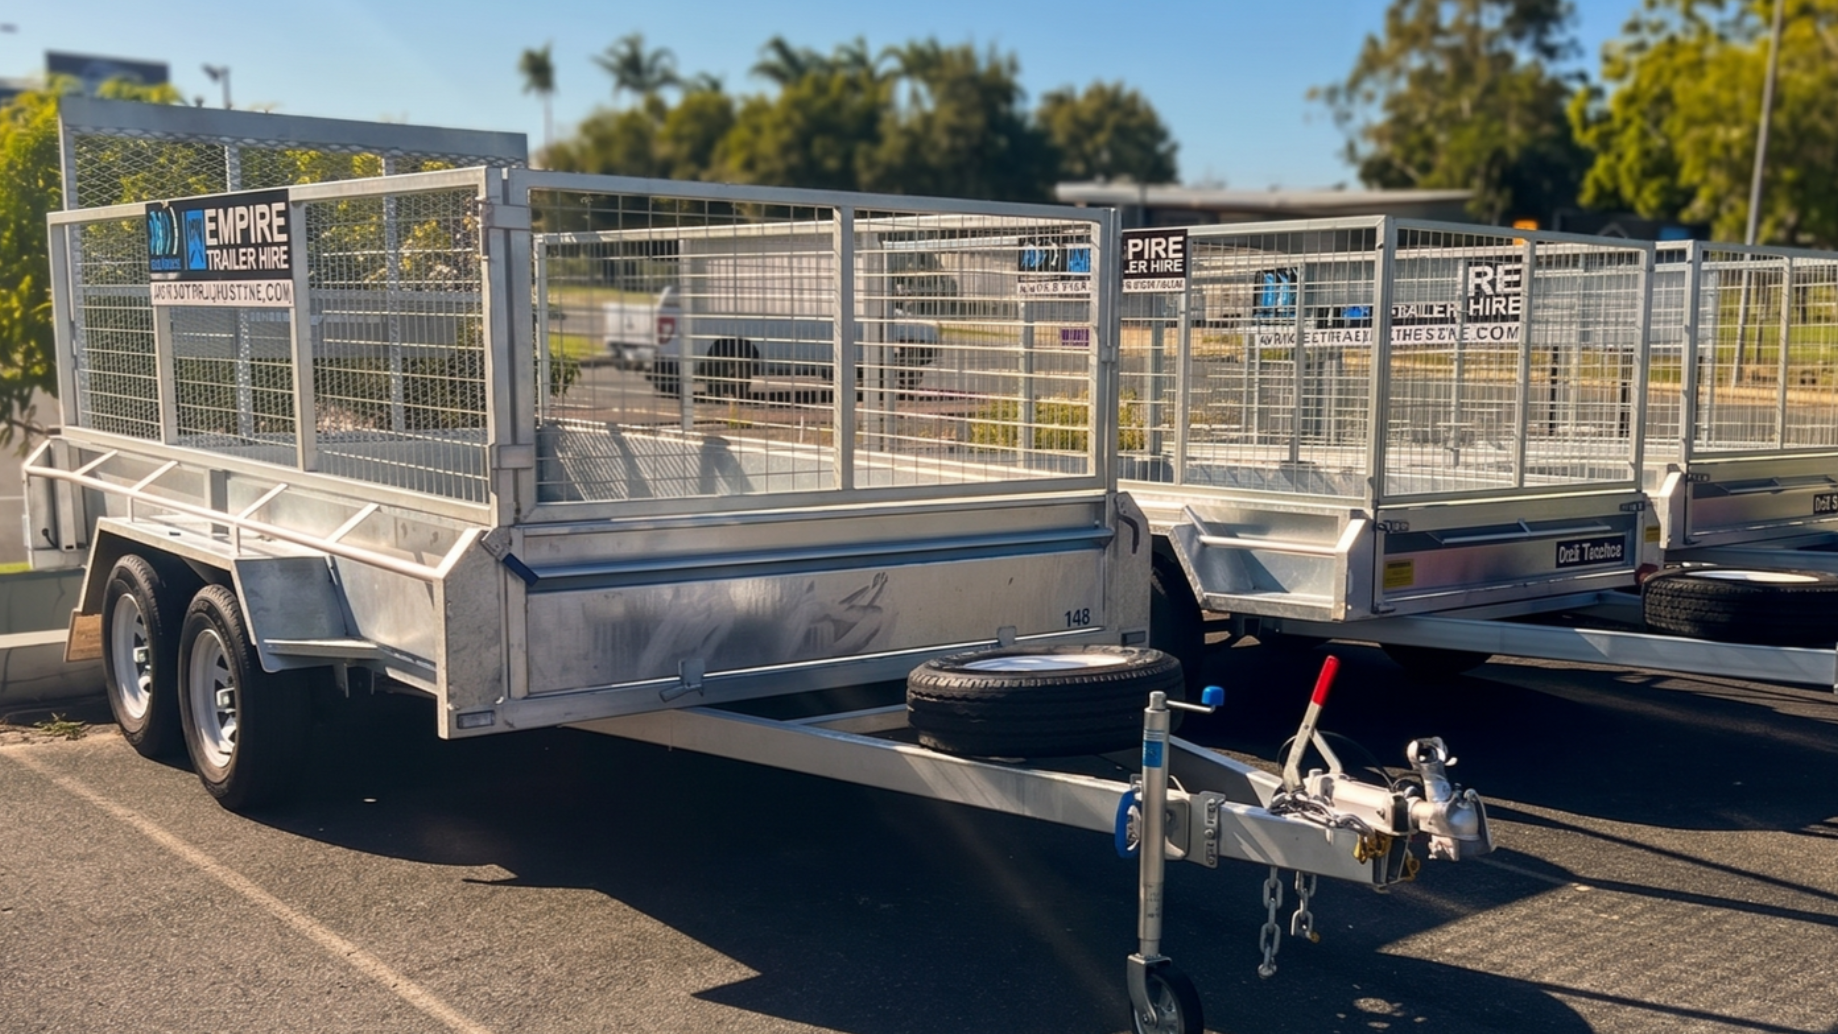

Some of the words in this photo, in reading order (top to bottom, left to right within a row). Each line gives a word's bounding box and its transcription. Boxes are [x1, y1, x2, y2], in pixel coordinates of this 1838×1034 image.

[204, 202, 288, 246] EMPIRE
[206, 247, 257, 271] TRAILER
[258, 246, 290, 269] HIRE
[1127, 236, 1184, 260] PIRE
[1150, 259, 1184, 273] HIRE
[1468, 296, 1521, 317] HIRE
[1064, 607, 1091, 628] 148
